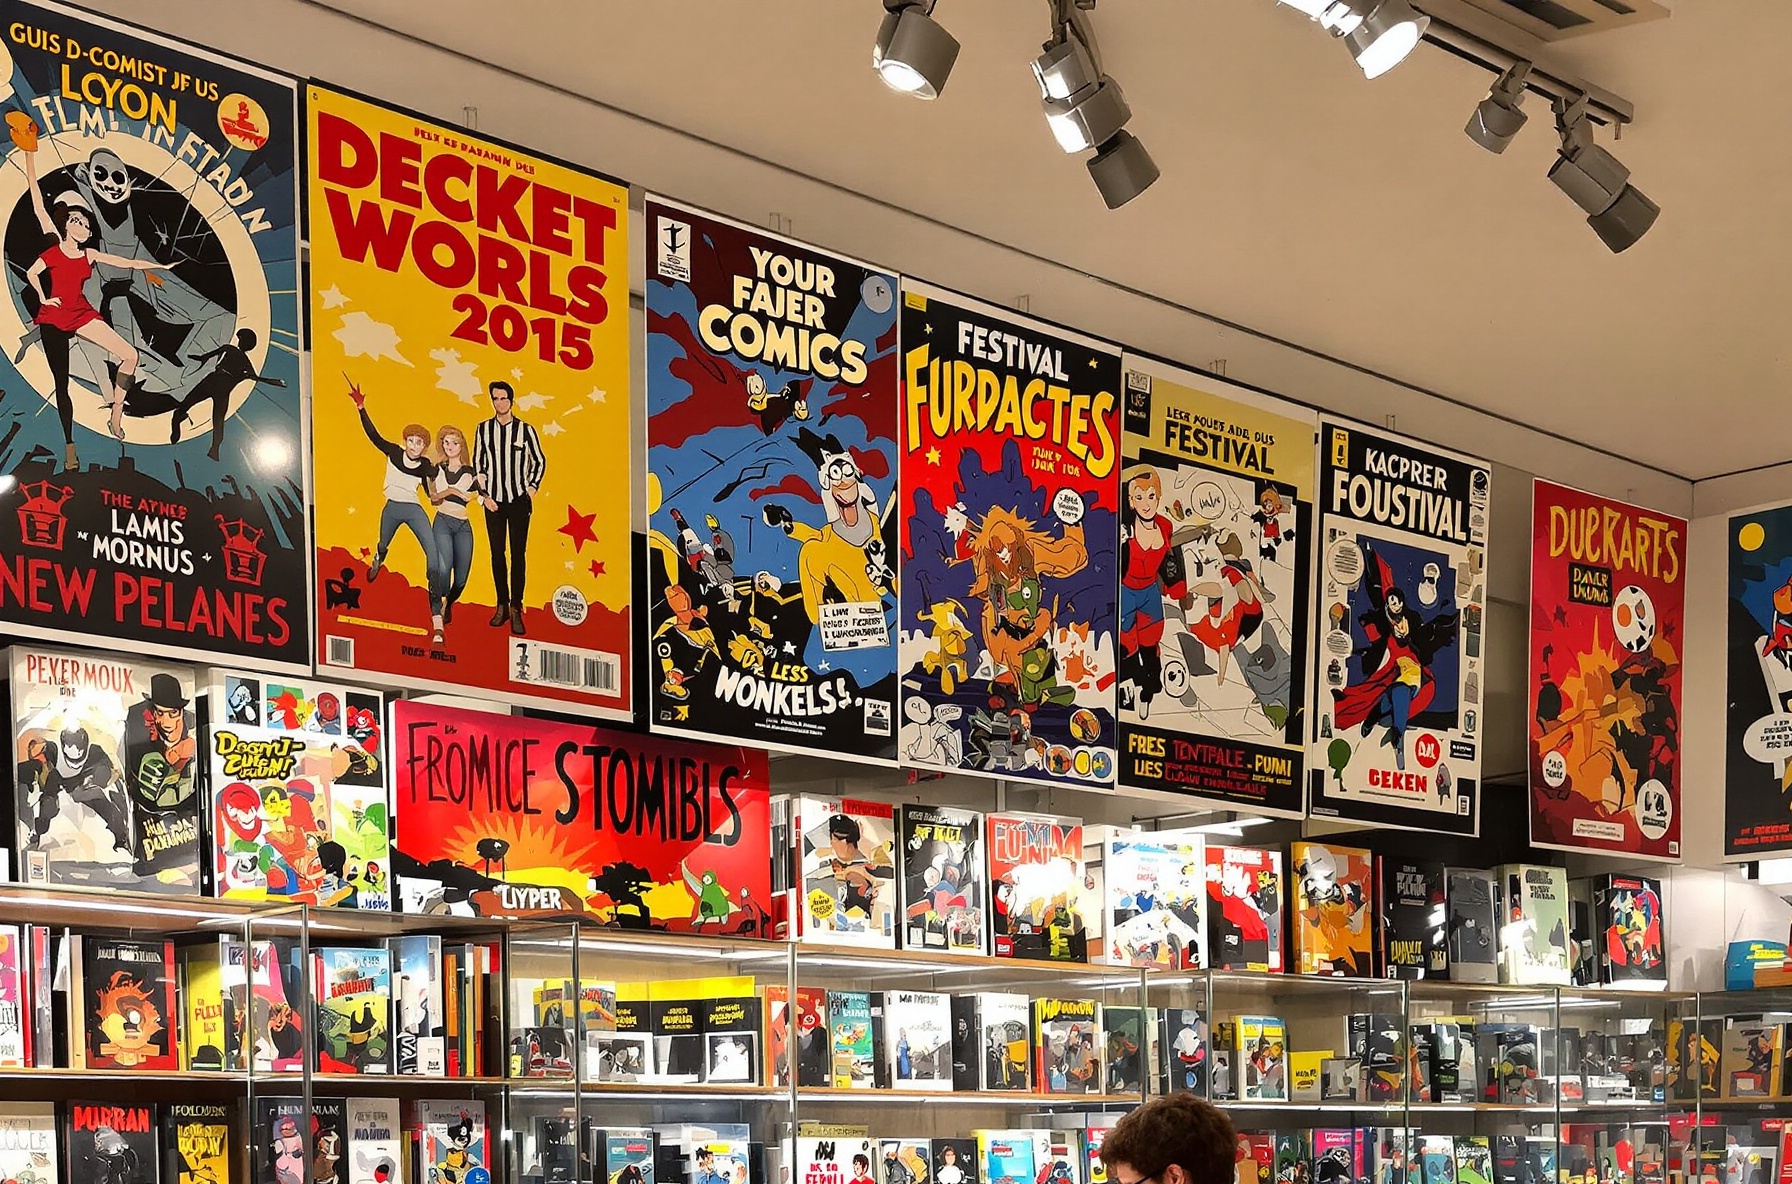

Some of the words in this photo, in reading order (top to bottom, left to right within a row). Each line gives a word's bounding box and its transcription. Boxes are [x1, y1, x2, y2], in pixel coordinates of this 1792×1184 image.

[9, 22, 61, 55] GUIS
[195, 80, 220, 103] US
[60, 63, 178, 134] LCYON
[318, 110, 617, 266] DECKET
[324, 187, 609, 325] WORLS
[749, 246, 836, 299] YOUR
[450, 293, 594, 370] 2015
[698, 303, 868, 385] COMICS
[958, 321, 1069, 382] FESTIVAL
[906, 343, 1115, 479] FURDACTES
[1165, 419, 1275, 475] FESTIVAL
[1365, 447, 1448, 492] KACPRER
[100, 489, 133, 510] THE
[111, 508, 185, 546] LAMIS
[1333, 468, 1468, 542] FOUSTIVAL
[93, 533, 195, 577] MORNUS
[0, 555, 97, 618] NEW
[114, 571, 290, 647] PELANES
[770, 661, 809, 684] LESS
